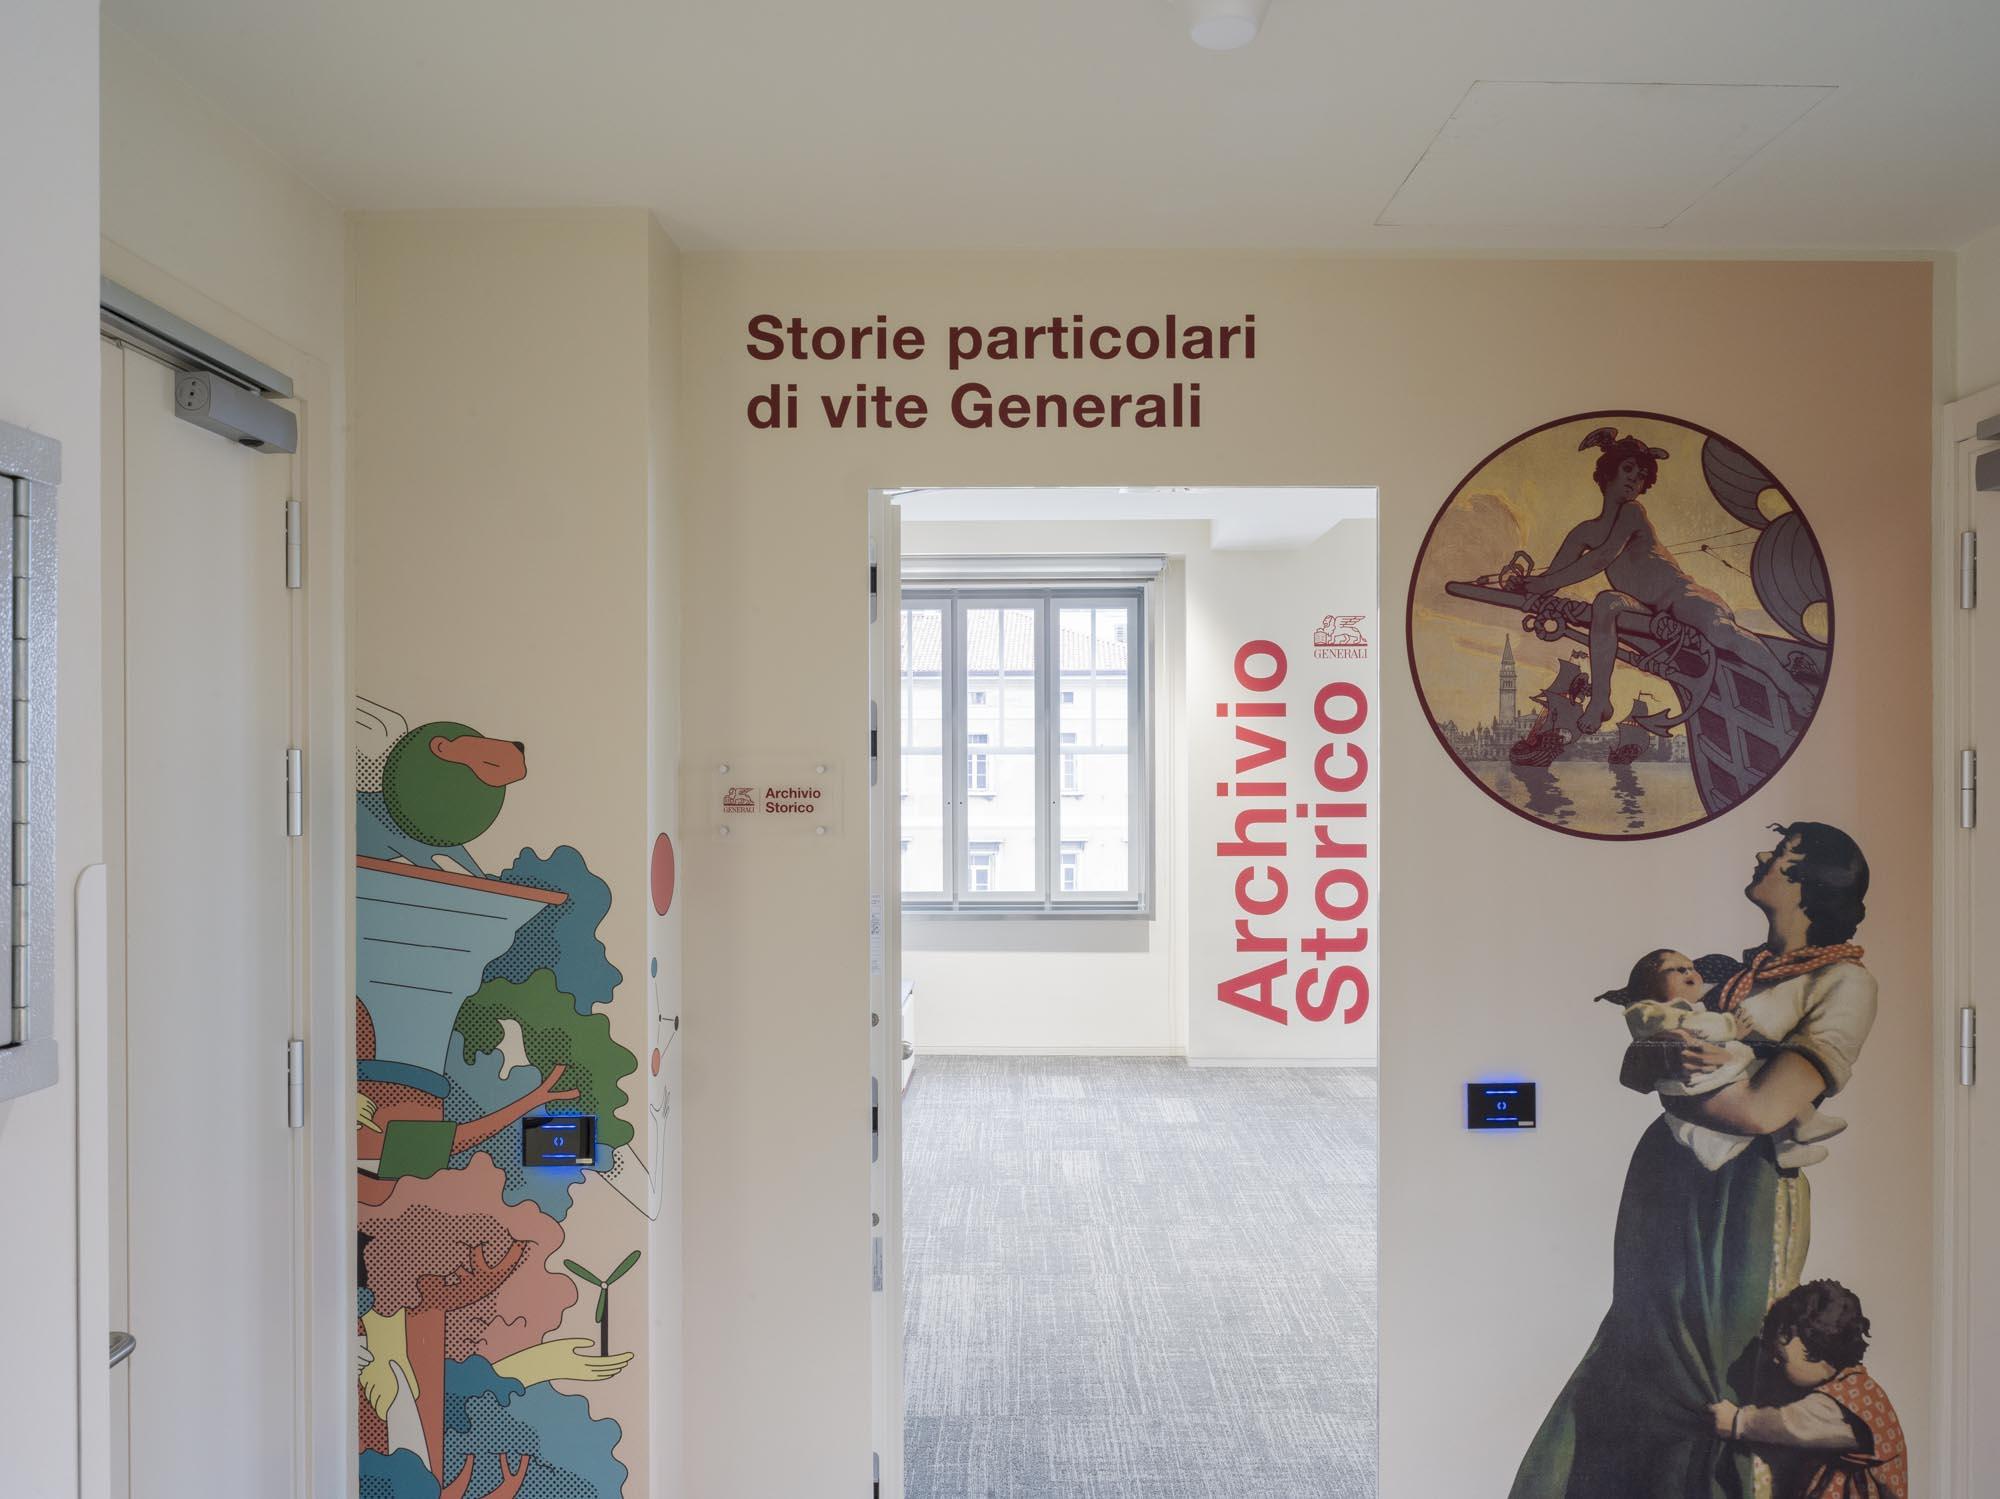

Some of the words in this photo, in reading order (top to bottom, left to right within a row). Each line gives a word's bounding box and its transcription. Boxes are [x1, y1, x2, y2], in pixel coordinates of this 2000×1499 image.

[747, 314, 926, 361] Storie
[948, 314, 1256, 370] particolari
[747, 383, 798, 429] di
[820, 383, 929, 429] vite
[951, 382, 1202, 429] Generali
[1313, 648, 1368, 659] GENERALI
[765, 787, 821, 799] Archivio
[765, 801, 814, 814] Storico
[723, 806, 755, 814] GENERALI
[1216, 639, 1289, 1026] Archivio
[1295, 681, 1370, 1025] Storico
